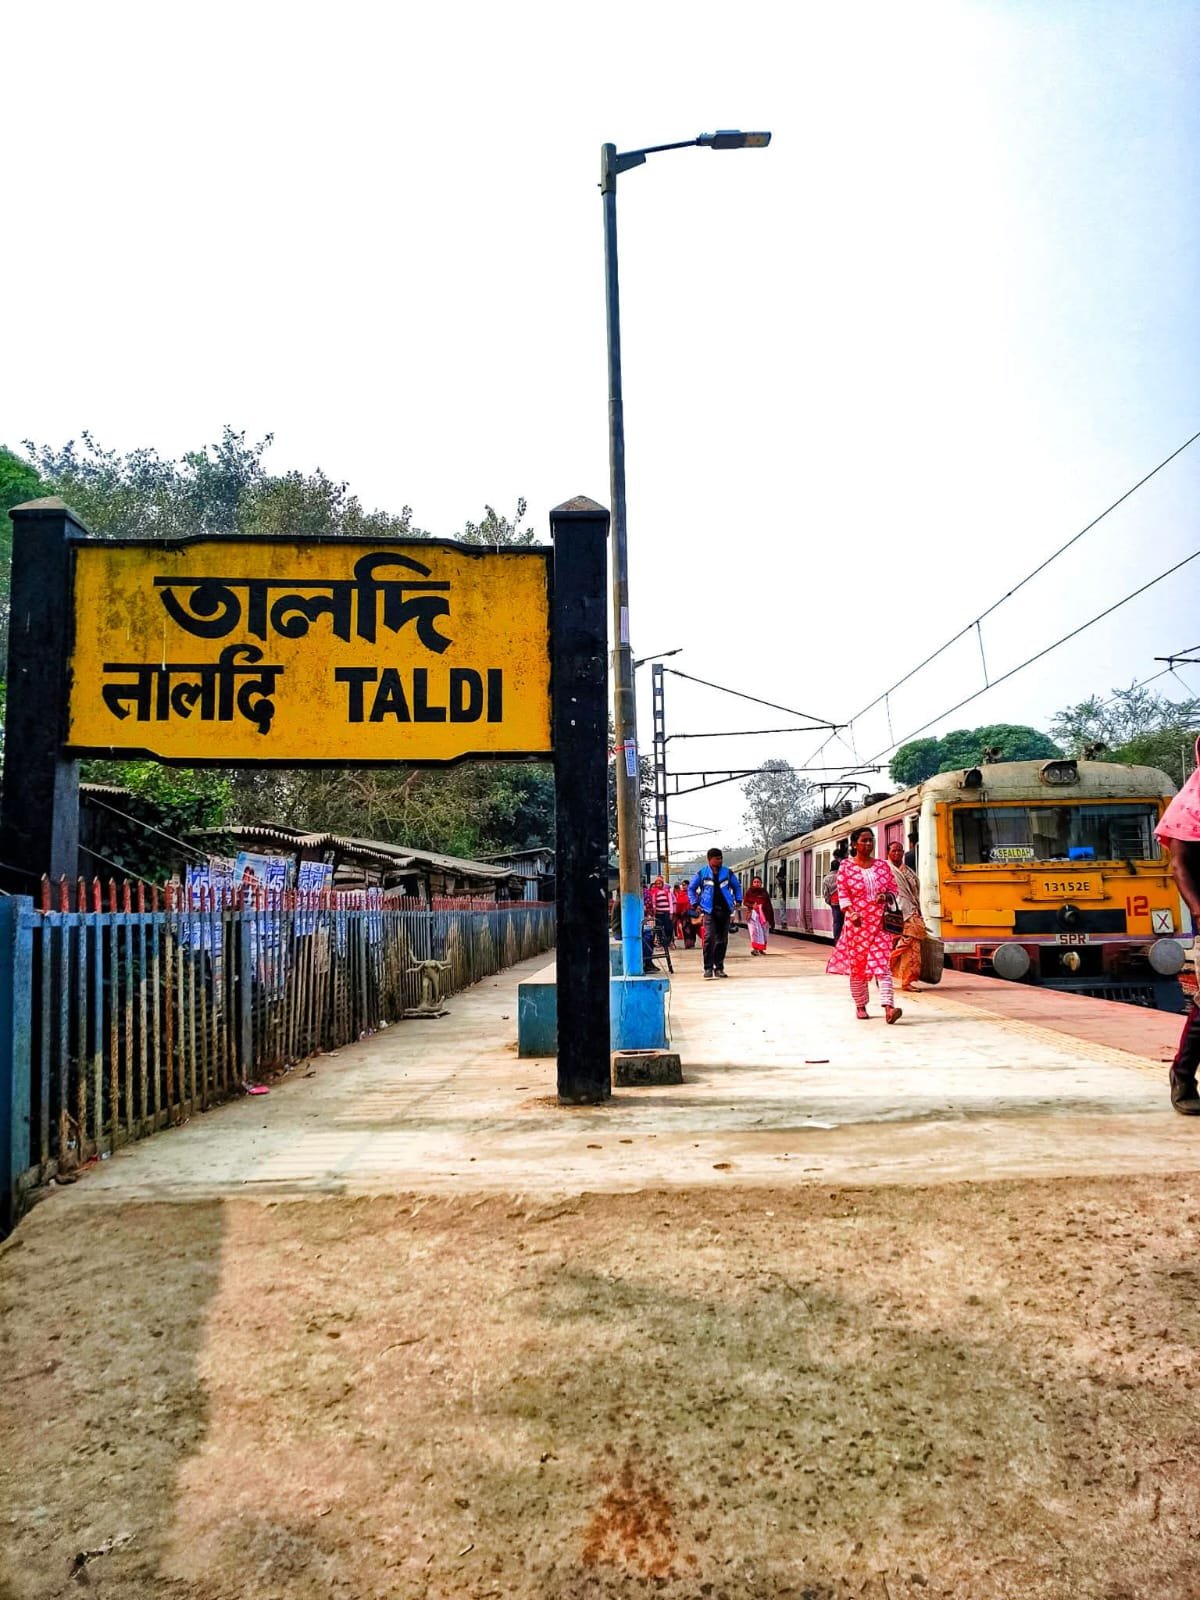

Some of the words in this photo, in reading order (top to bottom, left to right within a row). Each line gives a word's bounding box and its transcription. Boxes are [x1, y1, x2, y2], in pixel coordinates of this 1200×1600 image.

[153, 552, 453, 654] তালদি
[102, 643, 284, 735] तालदि
[335, 668, 503, 723] TALDI
[998, 848, 1031, 858] SEALDAH
[1044, 881, 1091, 892] 13152E
[1126, 895, 1149, 917] 12
[1059, 934, 1087, 945] SPR
